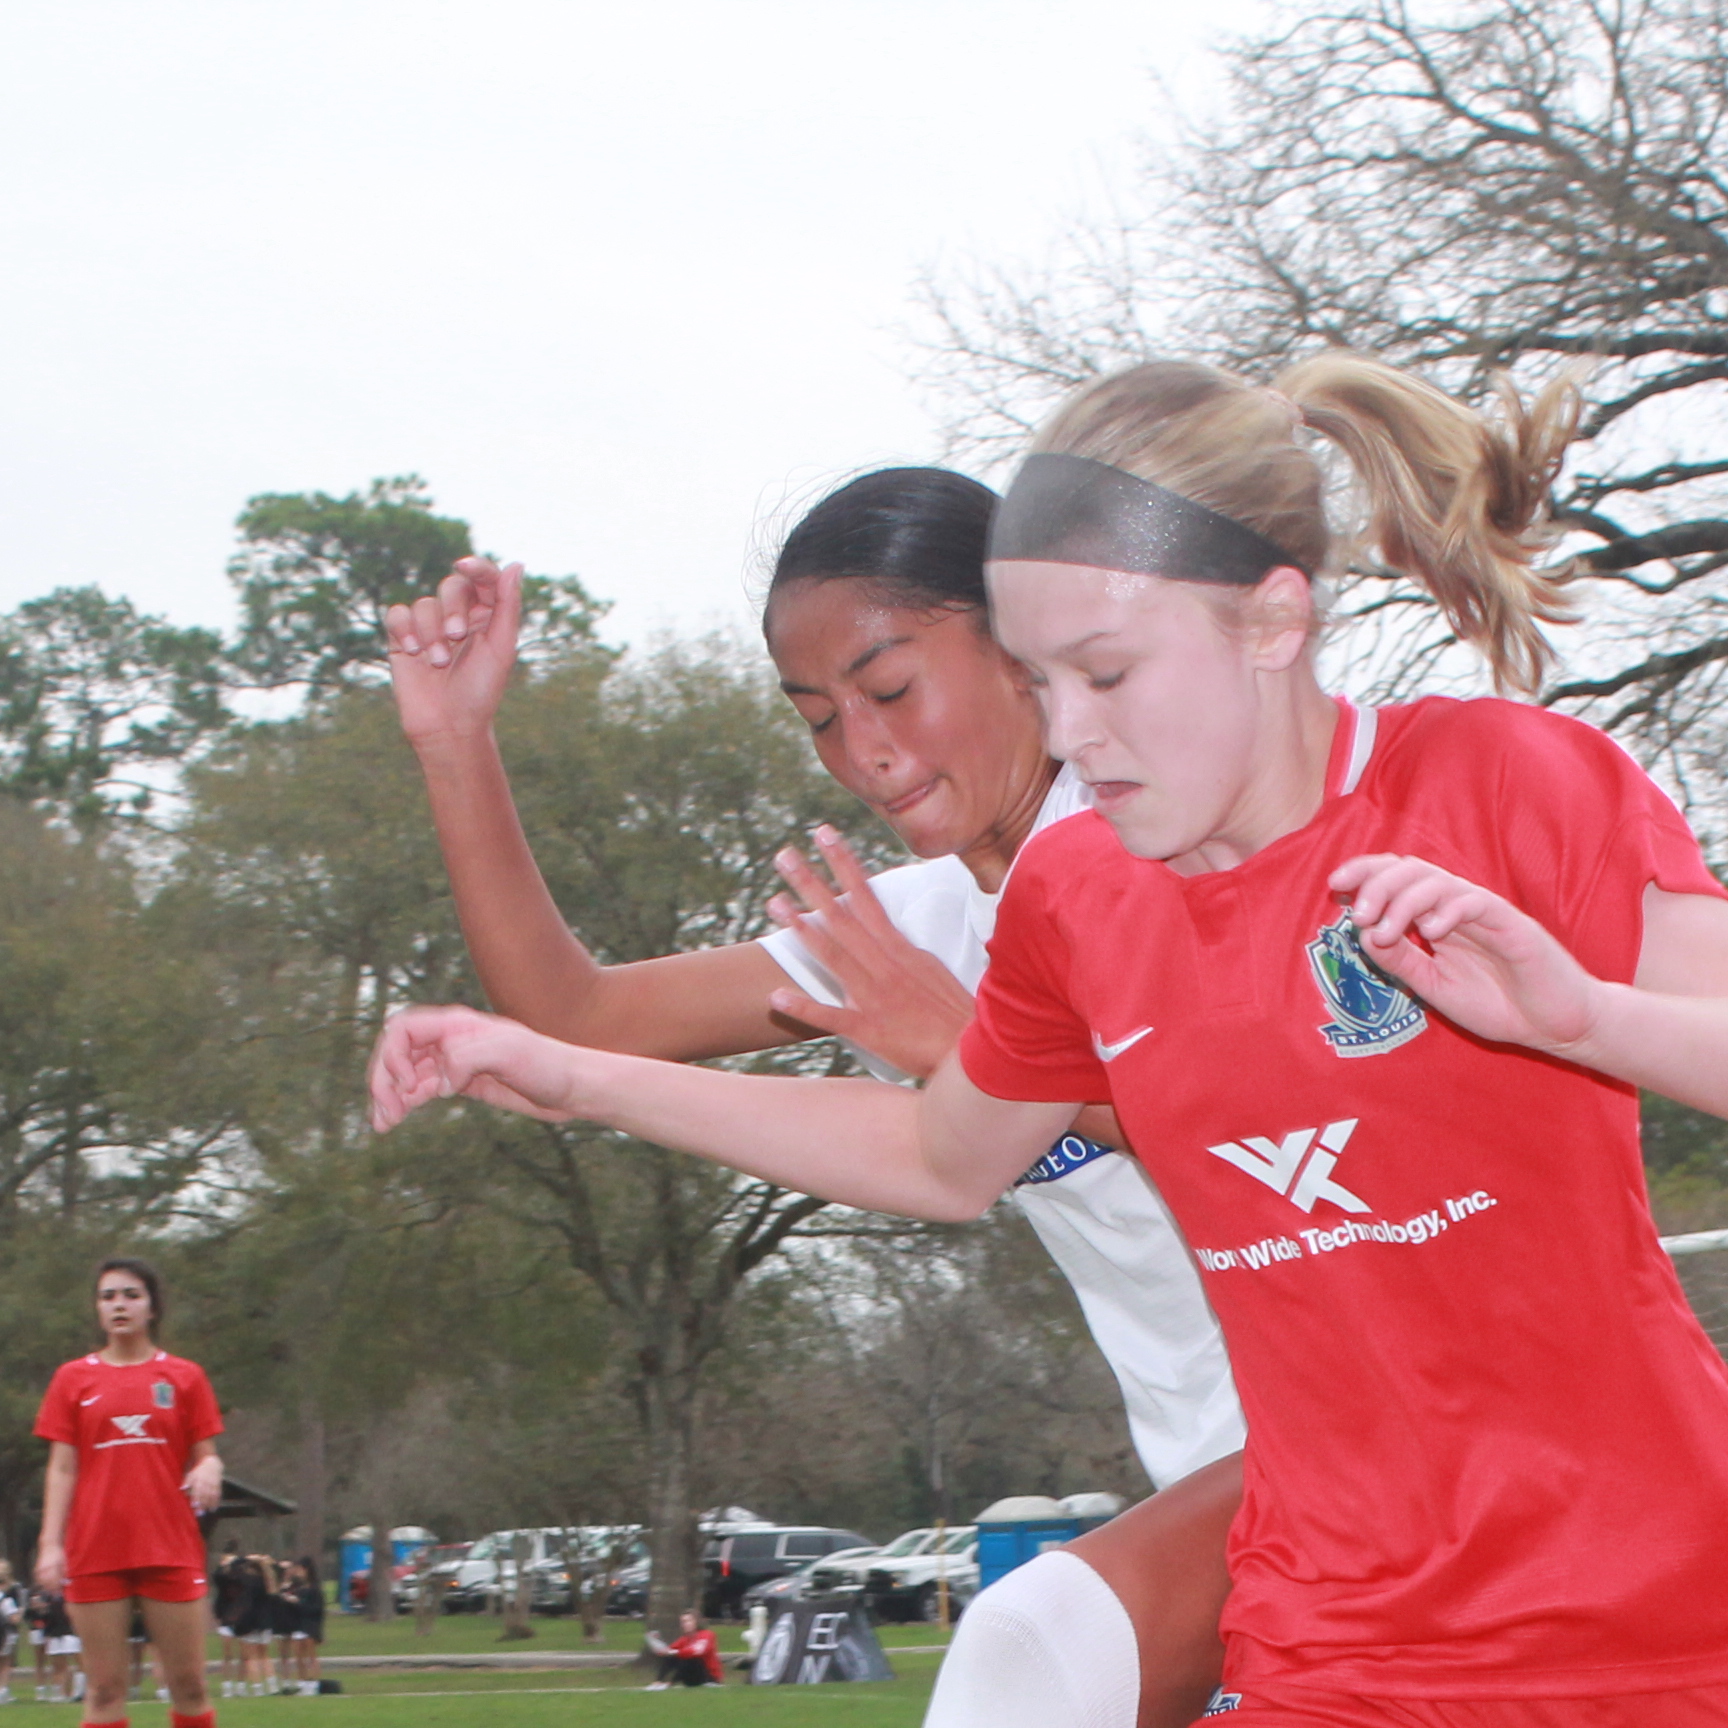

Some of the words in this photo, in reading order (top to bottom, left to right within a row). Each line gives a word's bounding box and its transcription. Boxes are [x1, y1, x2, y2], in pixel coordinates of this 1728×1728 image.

[1337, 1034, 1365, 1045] ST.
[1368, 1011, 1419, 1041] LOUIS
[1240, 1235, 1303, 1271] Wide
[1298, 1208, 1449, 1256] Technology,
[1444, 1190, 1498, 1223] Inc.
